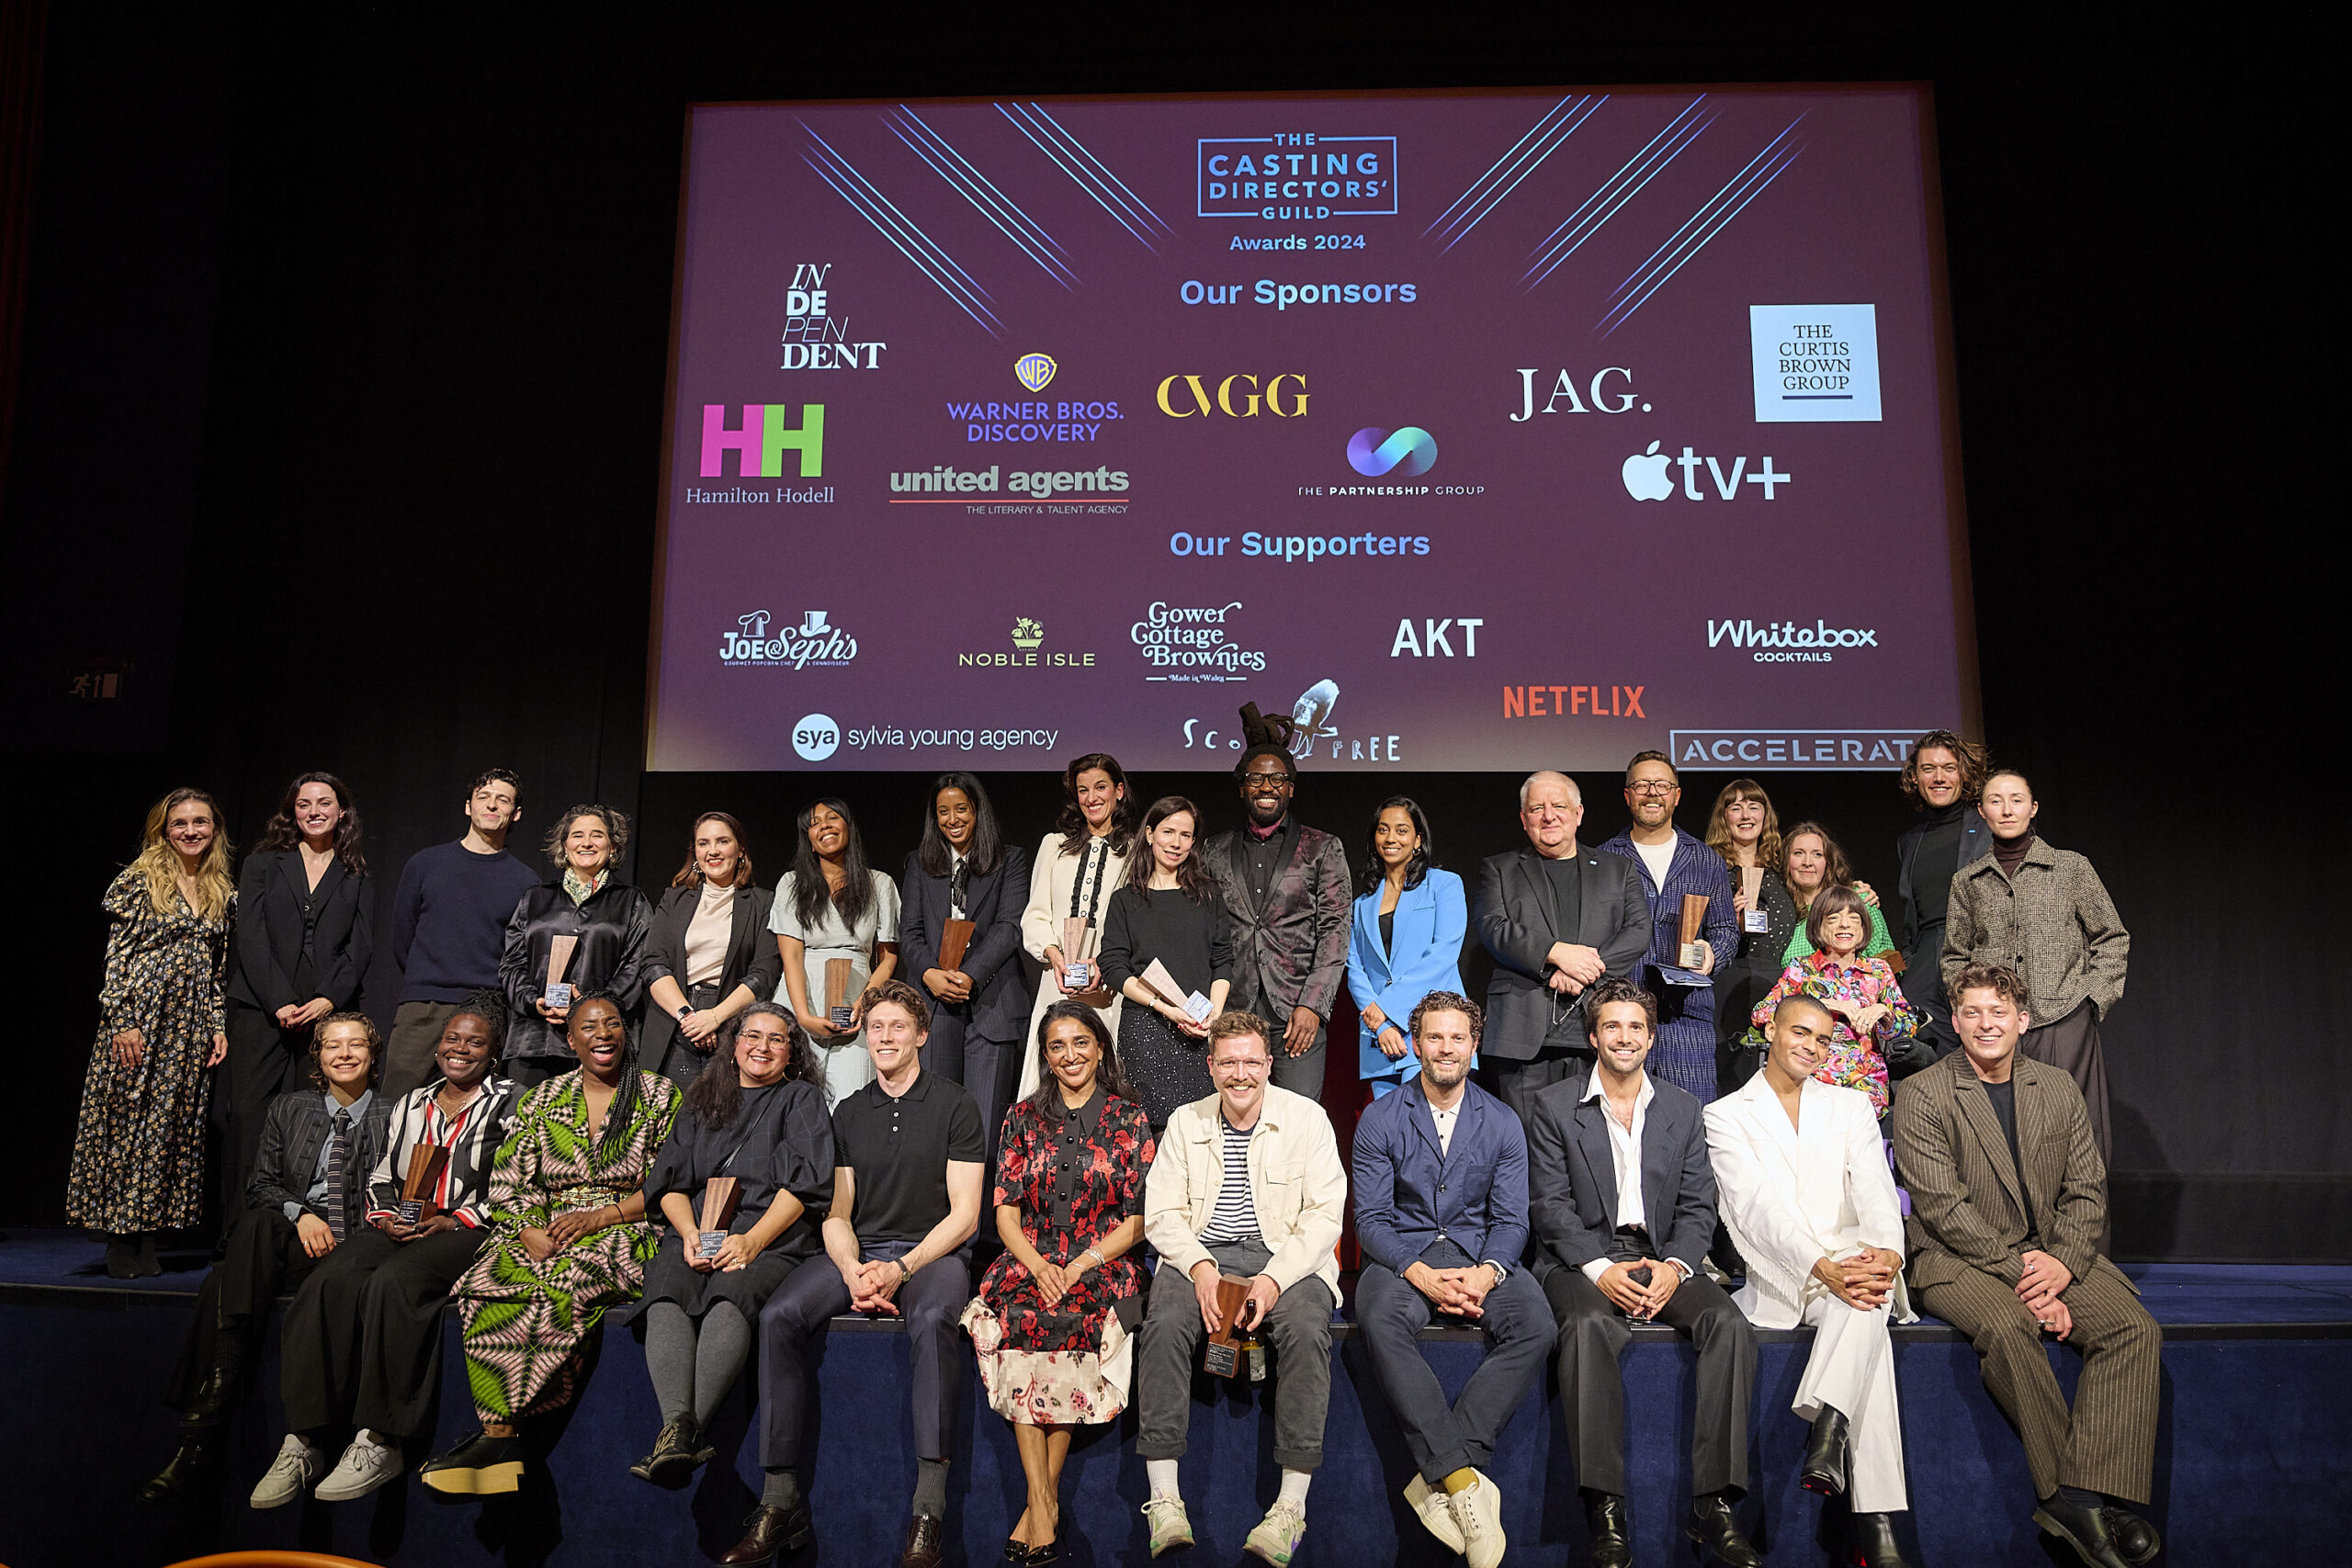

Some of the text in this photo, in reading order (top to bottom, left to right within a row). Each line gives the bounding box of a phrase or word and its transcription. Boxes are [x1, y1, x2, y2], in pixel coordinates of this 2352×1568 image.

[1273, 133, 1316, 147] THE
[1207, 152, 1379, 177] CASTING
[1209, 179, 1388, 199] DIRECTORS'
[1261, 205, 1330, 220] GUILD
[1229, 233, 1367, 251] Awards 2024
[788, 263, 832, 290] IN
[787, 289, 828, 317] DE
[1180, 278, 1418, 311] Our Sponsors
[781, 316, 849, 343] PEN
[1792, 324, 1833, 339] THE
[780, 342, 888, 370] DENT
[1779, 342, 1849, 356] CURTIS
[1779, 358, 1851, 373] BROWN
[1783, 376, 1849, 390] GROUP
[1509, 367, 1653, 423] JAG.
[945, 400, 1125, 421] WARNER BROS.
[967, 423, 1102, 443] DISCOVERY
[890, 465, 1130, 499] united agents
[1298, 485, 1485, 496] THE PARTNERSHIP GROUP
[685, 486, 834, 504] Hamilton Hodell
[966, 505, 1128, 514] THE LITERARY & TALENT AGENCY
[1170, 531, 1430, 563] Our Supporters
[1148, 601, 1243, 629] Gower
[1131, 621, 1224, 649] Cottage
[1390, 617, 1484, 658] AKT
[1707, 618, 1879, 649] Whitebox
[958, 653, 1096, 668] NOBLE ISLE
[1141, 642, 1267, 672] Brownies
[1753, 651, 1833, 663] COCKTAILS
[1169, 673, 1190, 682] Made
[1200, 673, 1225, 683] Wales
[1503, 685, 1646, 719] NETFLIX
[796, 730, 836, 750] sya
[847, 724, 1059, 750] sylvia young agency
[1682, 739, 1914, 762] ACCELERAT
